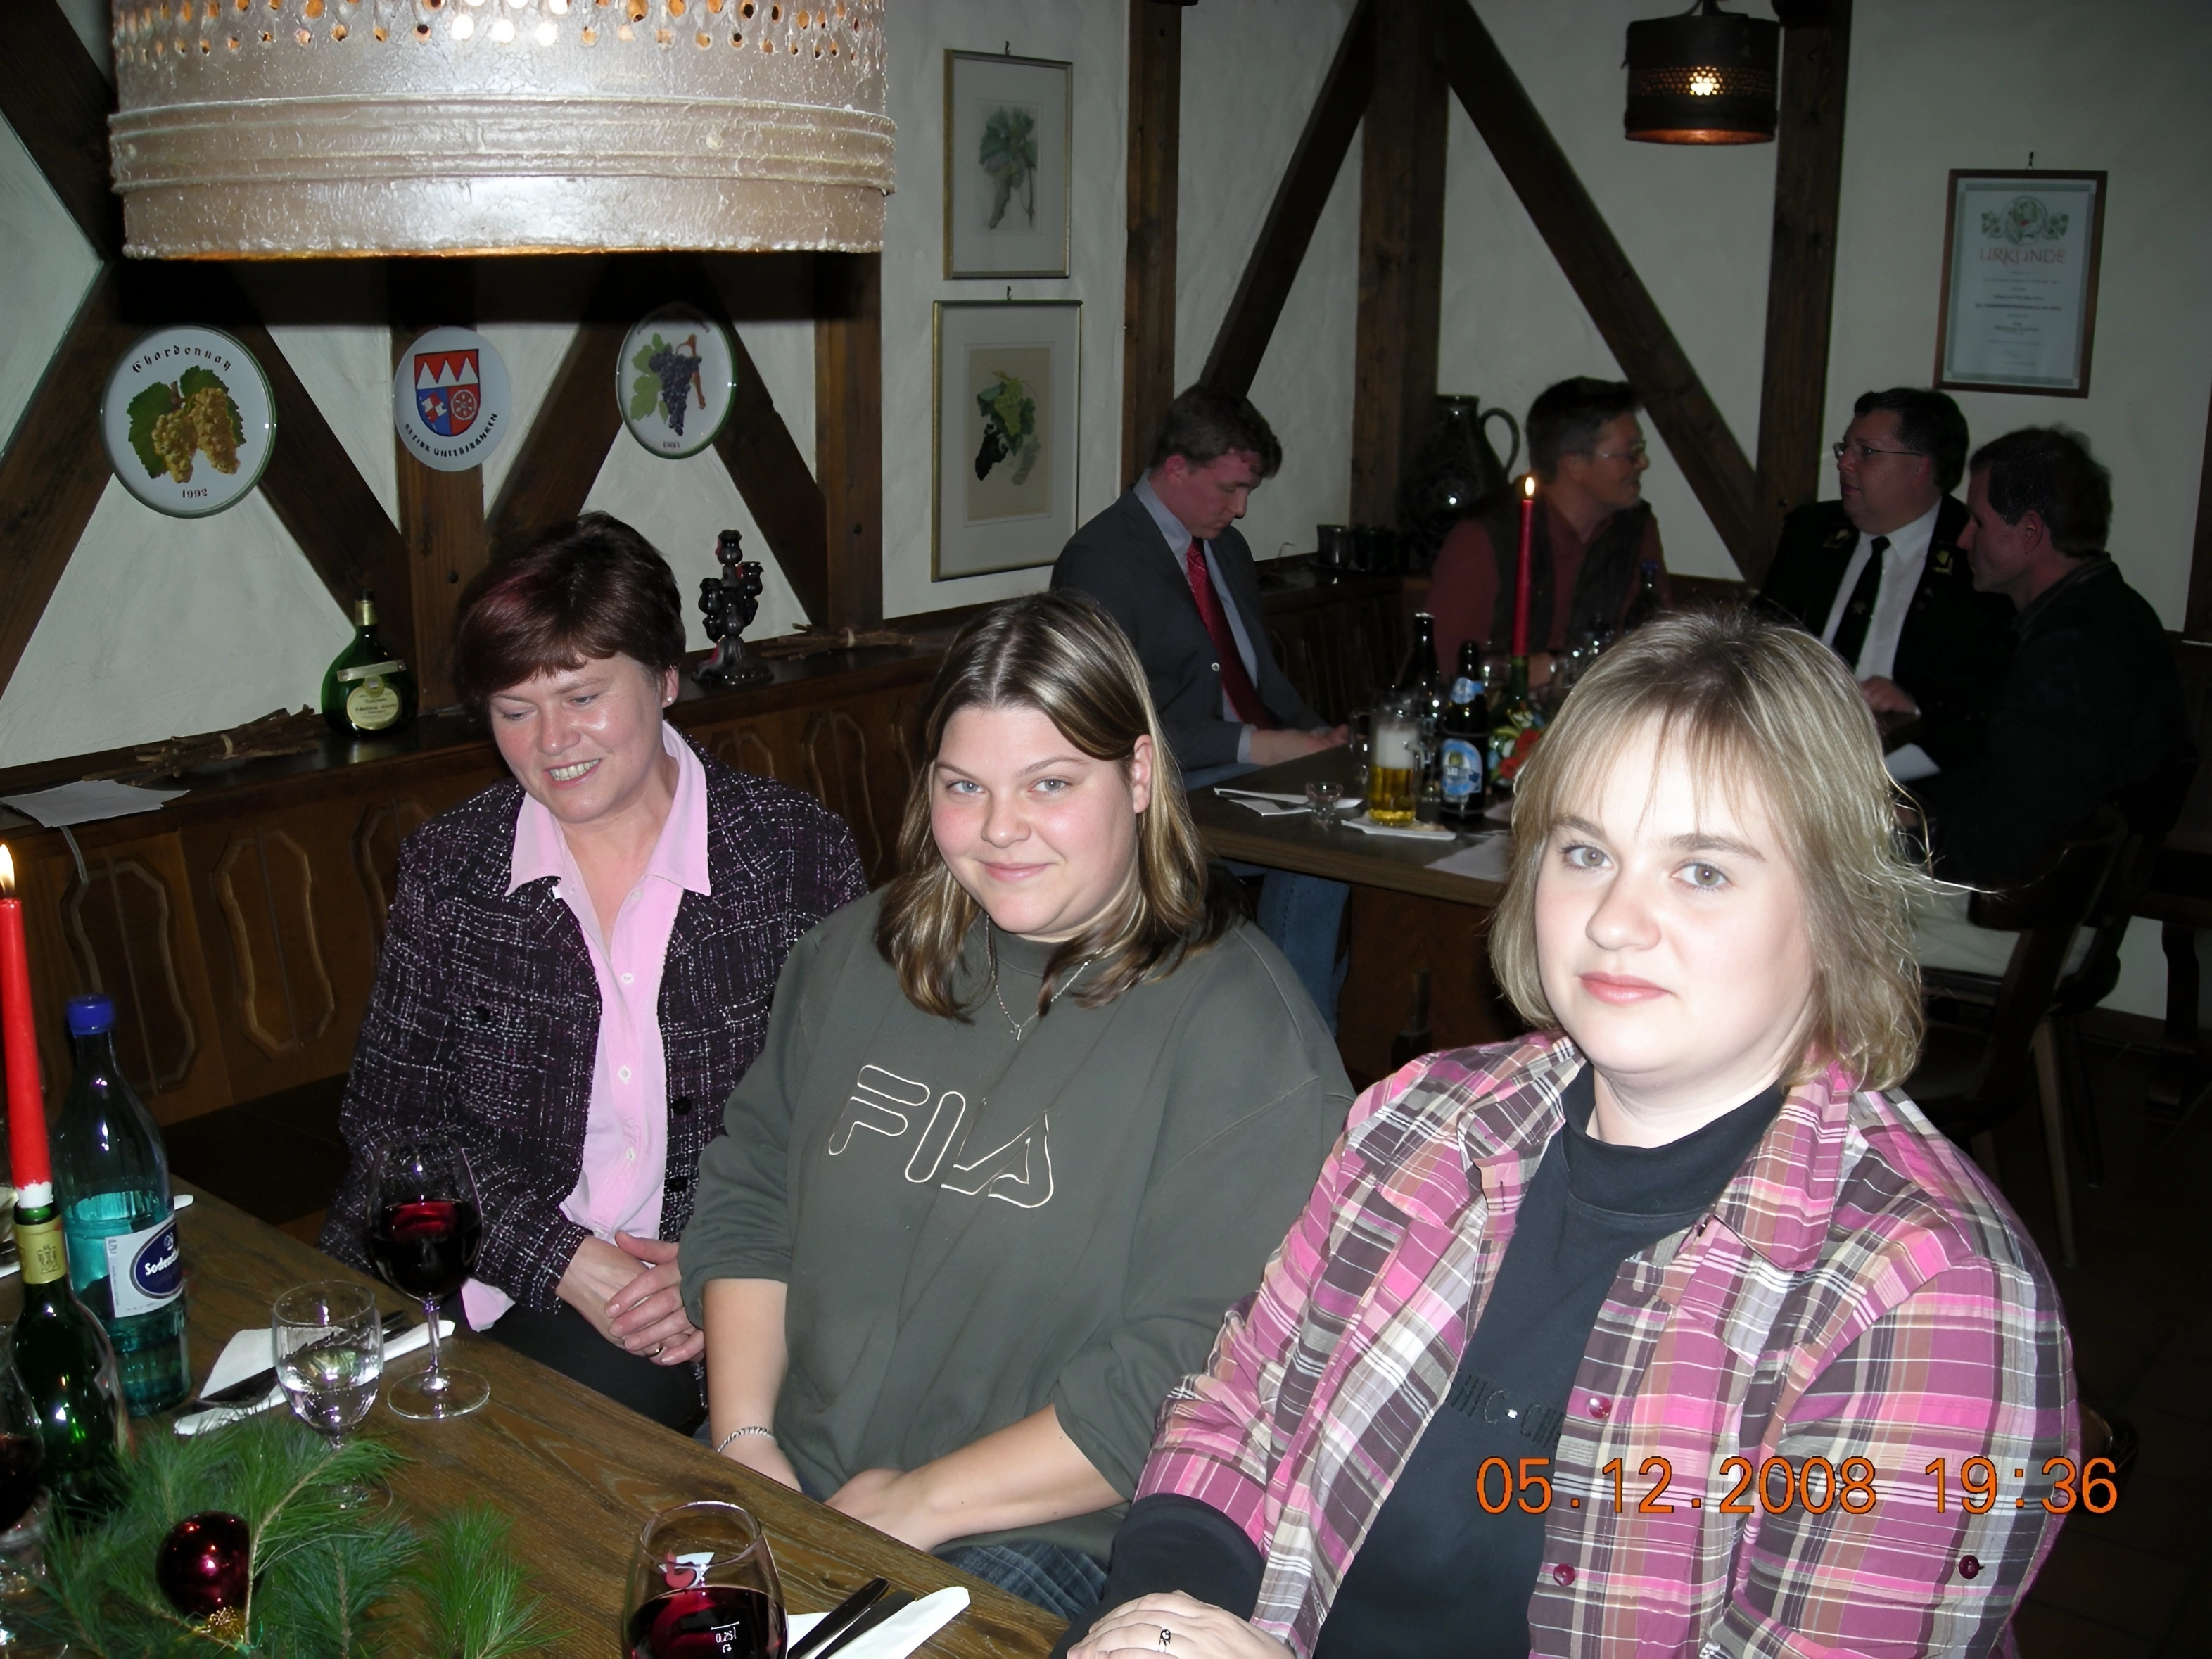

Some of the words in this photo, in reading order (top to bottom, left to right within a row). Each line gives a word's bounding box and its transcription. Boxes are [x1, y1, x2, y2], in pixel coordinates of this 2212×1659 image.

[1979, 247, 2066, 266] URKUNDE
[132, 345, 231, 374] Chardonnay
[182, 488, 208, 499] 1992
[828, 1064, 1055, 1209] FILA
